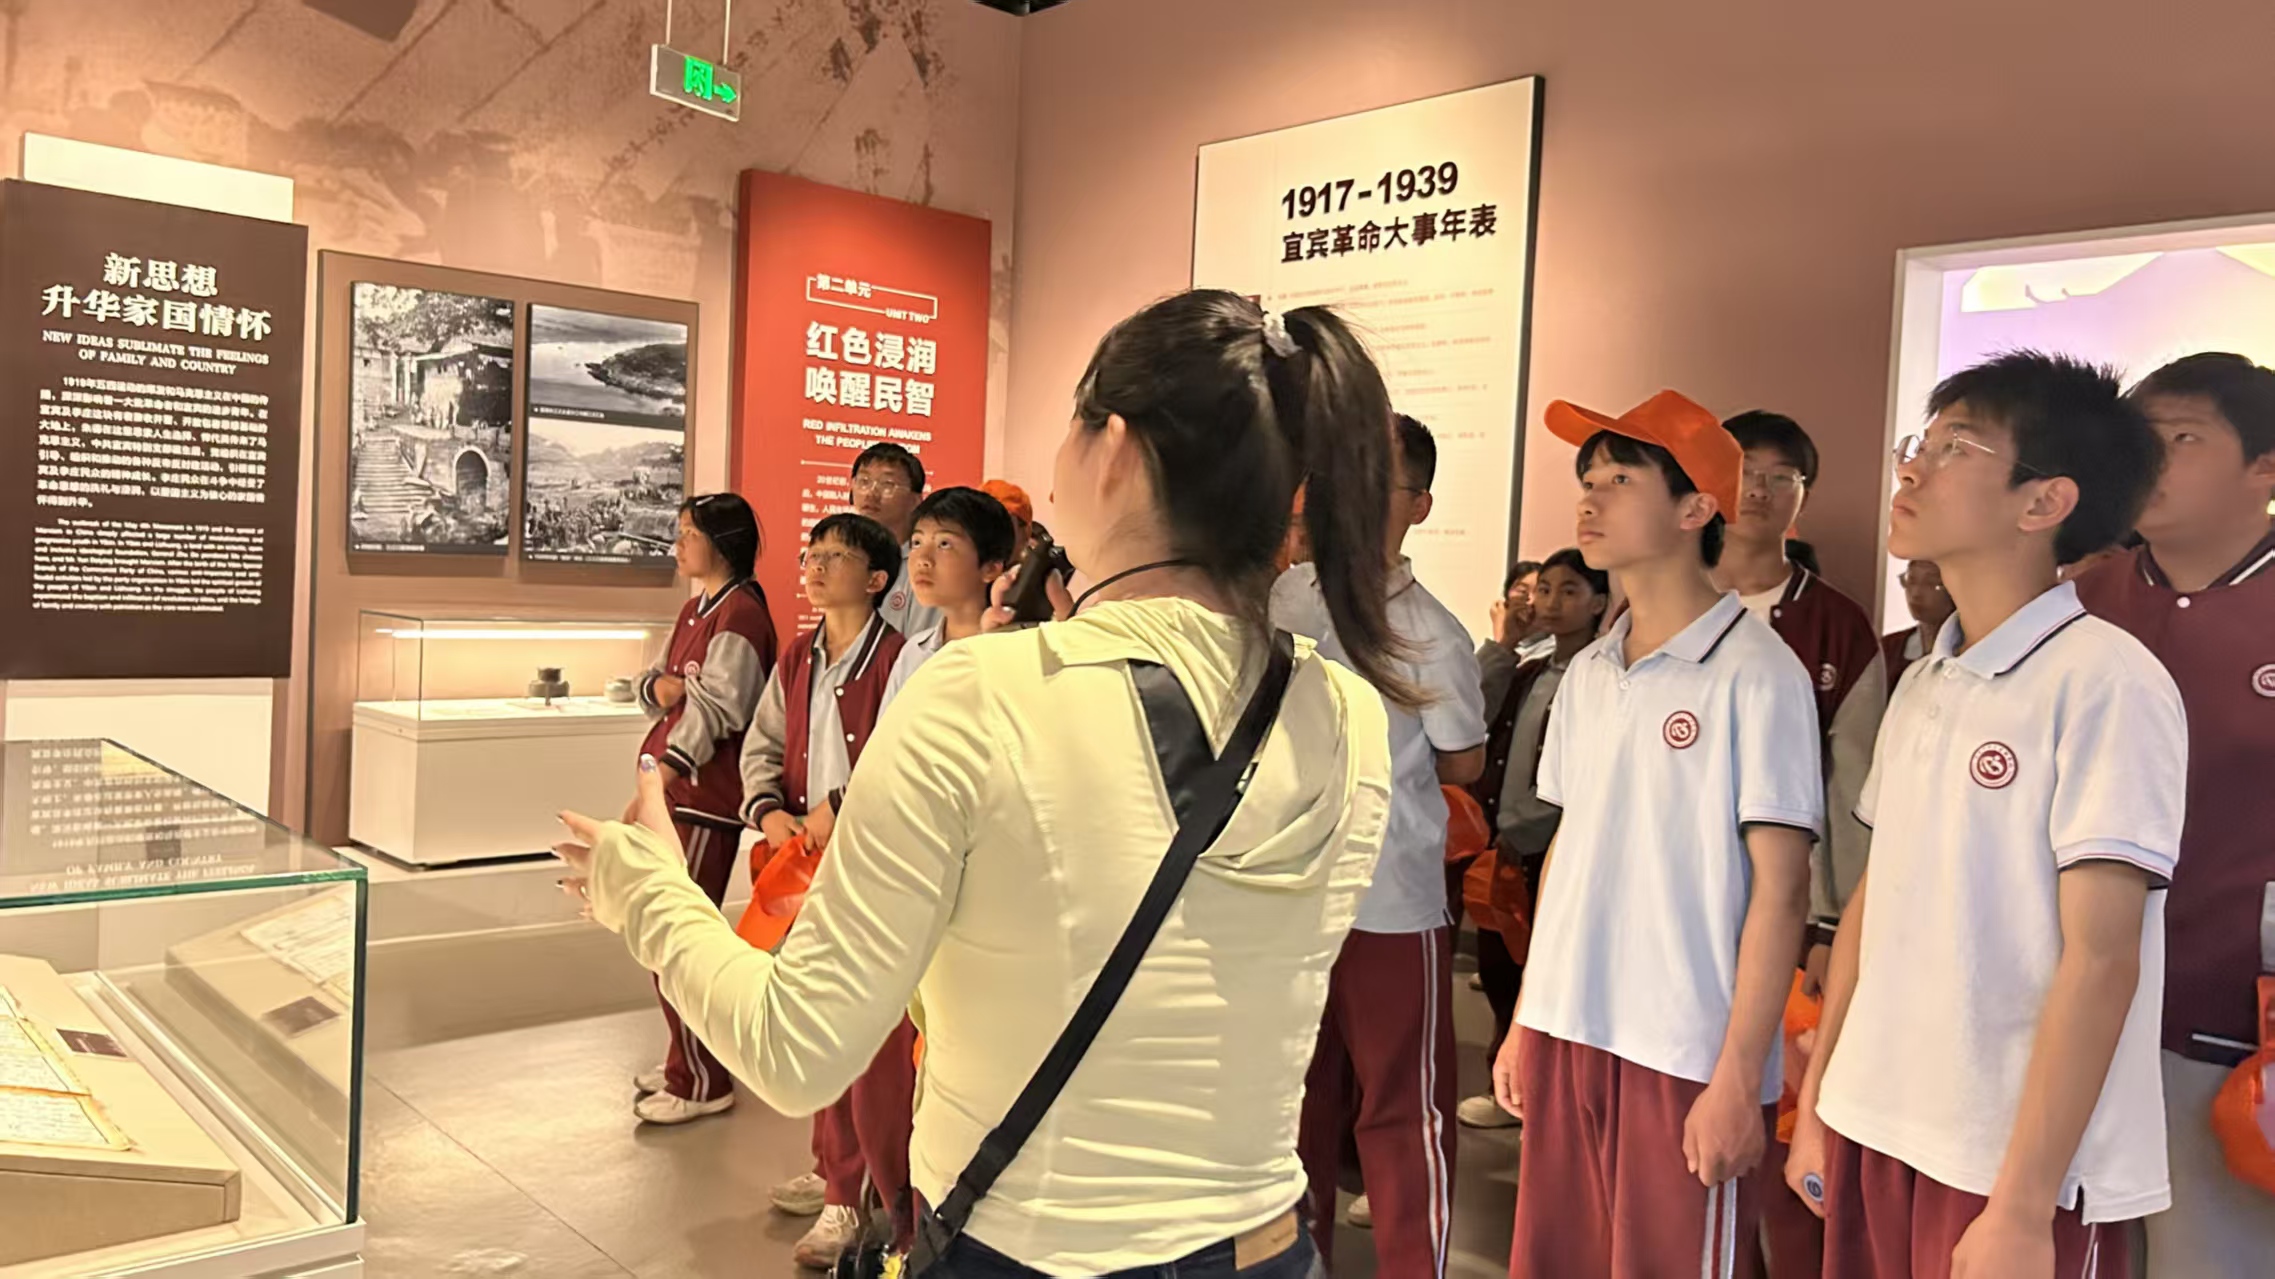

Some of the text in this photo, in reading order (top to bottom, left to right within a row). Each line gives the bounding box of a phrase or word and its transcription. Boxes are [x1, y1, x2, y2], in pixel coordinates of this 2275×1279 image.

[1281, 203, 1498, 264] 宜宾革命大事年表
[103, 252, 218, 297] 新思想
[816, 273, 871, 299] 第二单元
[41, 284, 272, 341] 升华家国情怀
[885, 307, 930, 324] UNIT TWO
[42, 330, 270, 365] NEW IDEAS SUBLIMATE THE FEELINGS
[78, 348, 237, 375] OF FAMILY AND COUNTRY
[806, 320, 937, 375] 红色浸润
[805, 366, 935, 417] 唤醒民智
[802, 418, 932, 442] RED INFILTRATION AWAKENS
[816, 434, 834, 446] THE
